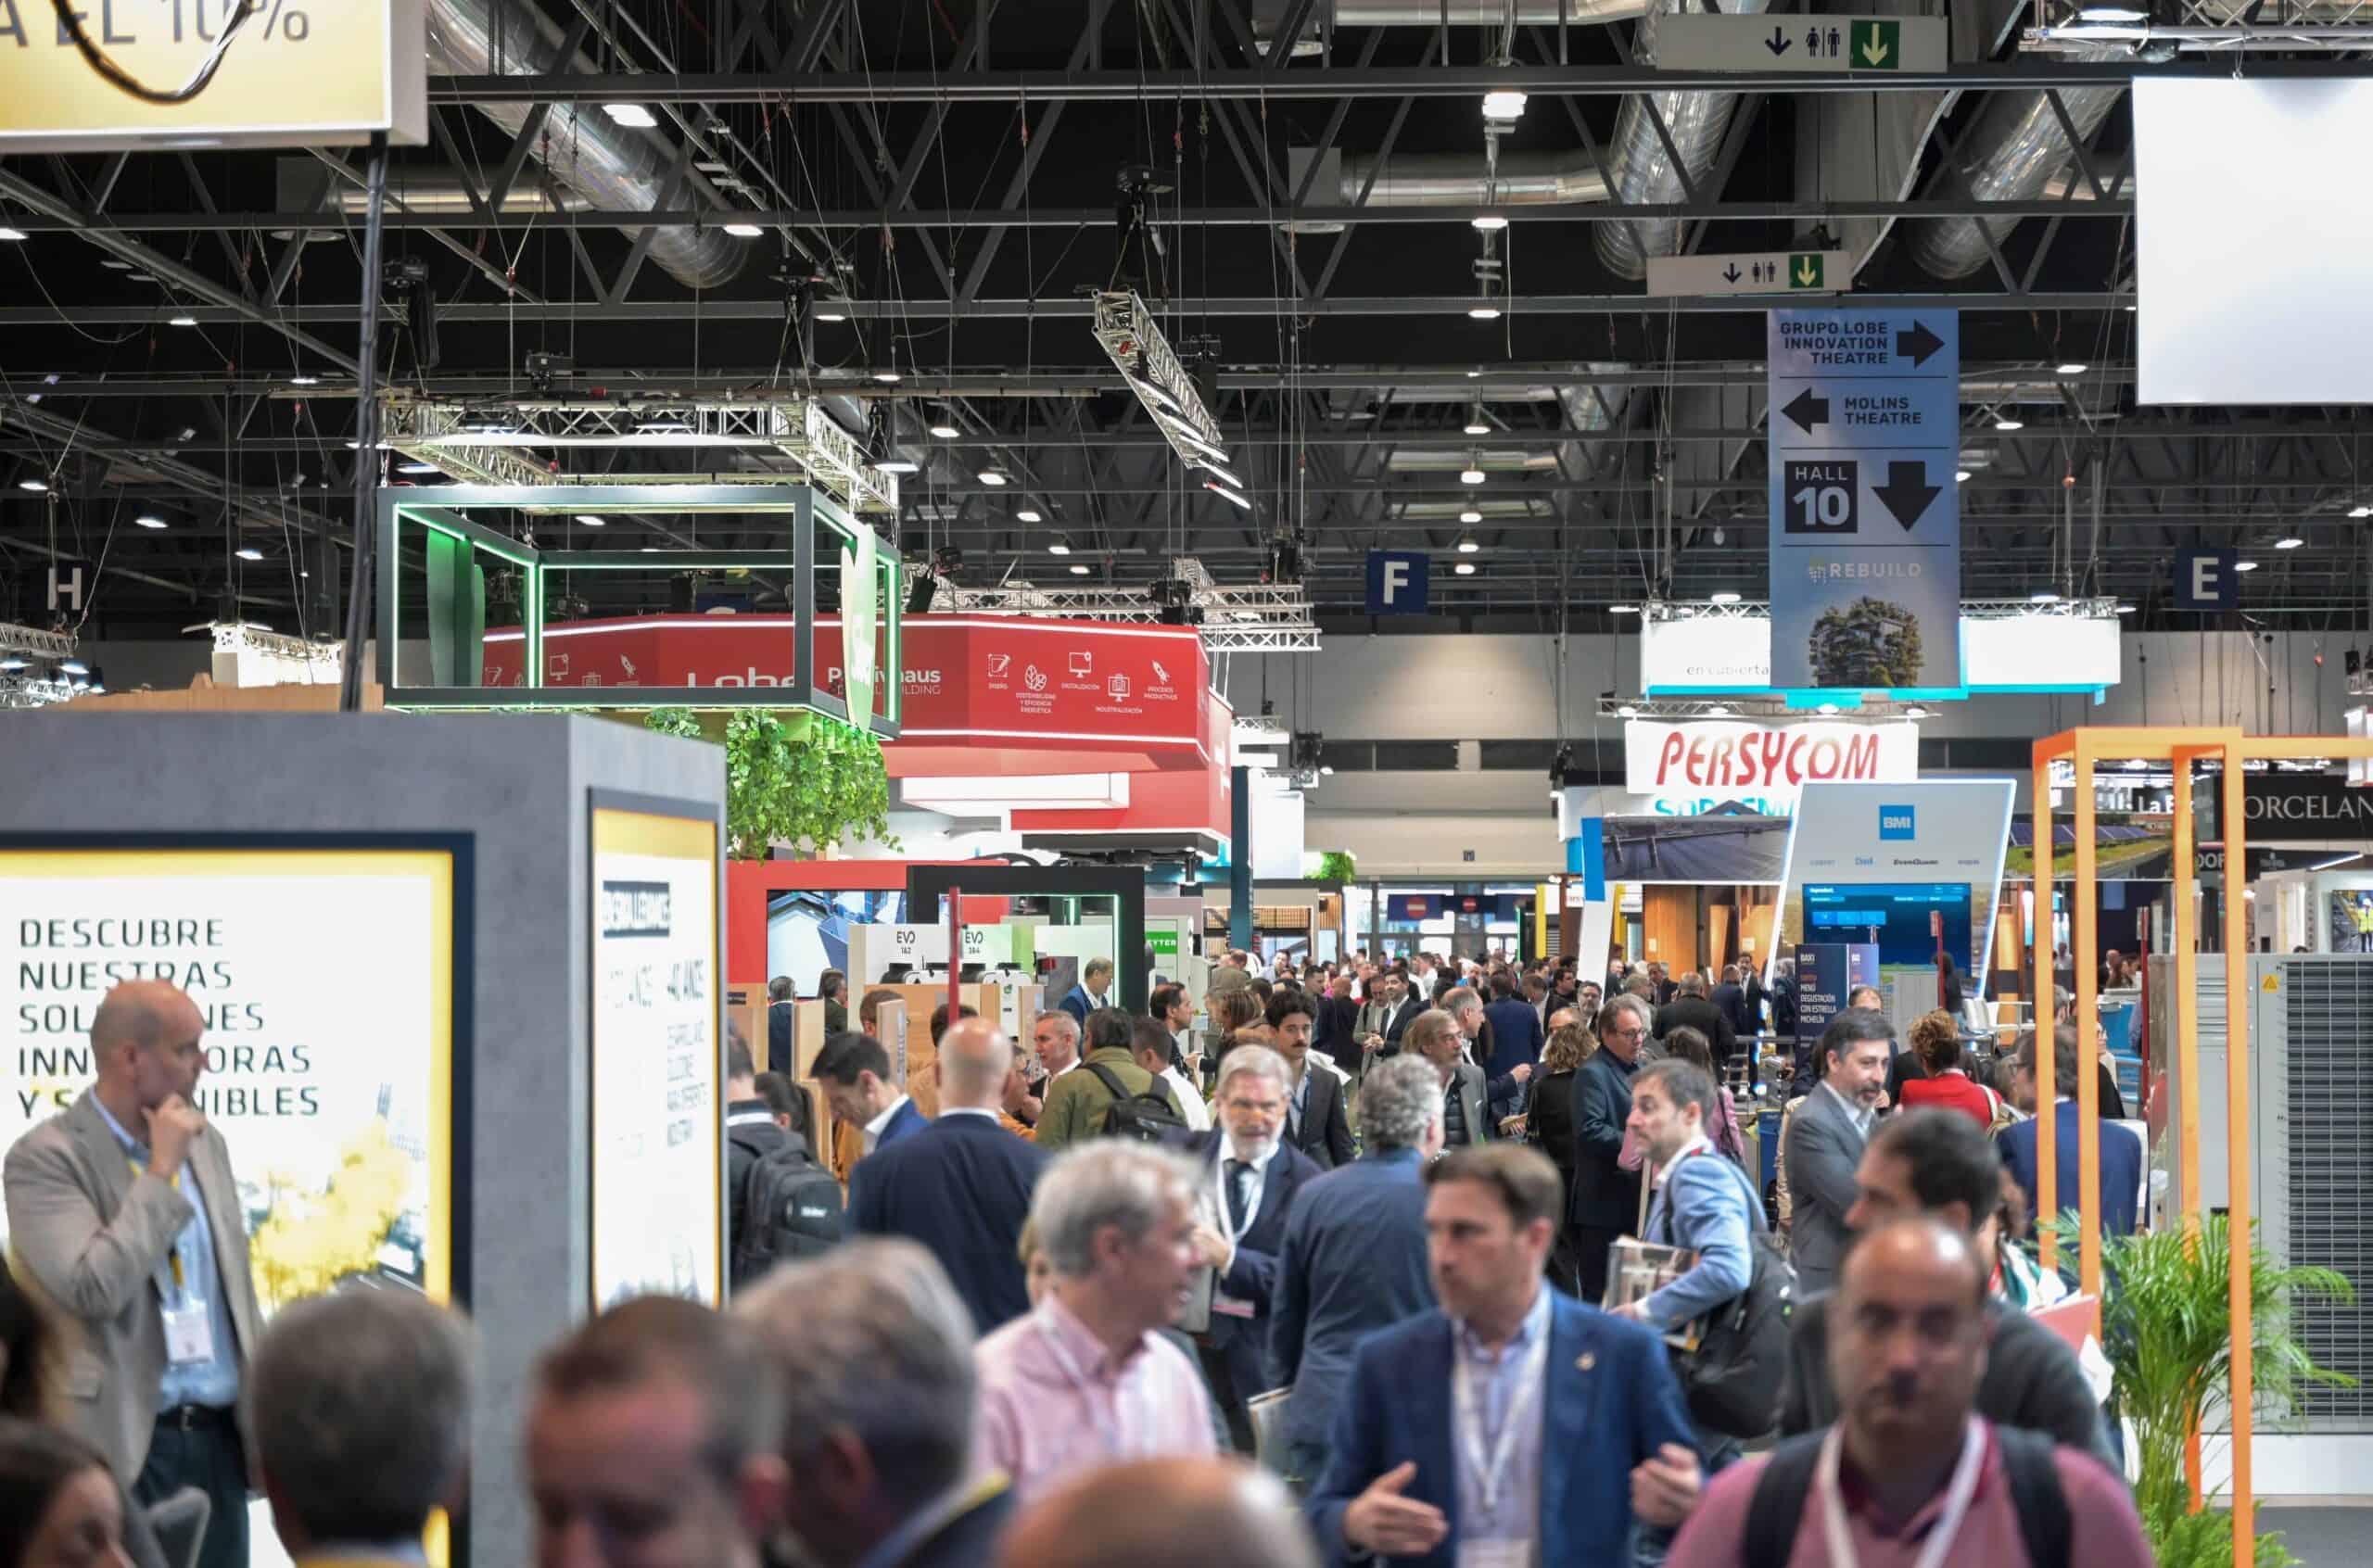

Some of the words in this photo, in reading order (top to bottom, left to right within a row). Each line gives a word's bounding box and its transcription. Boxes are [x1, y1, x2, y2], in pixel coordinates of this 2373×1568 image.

[1780, 322, 1838, 335] GRUPO
[1844, 322, 1887, 335] LOBE
[1784, 336, 1887, 349] INNOVATION
[1811, 352, 1888, 364] THEATRE
[1845, 397, 1909, 410] MOLINS
[1845, 412, 1921, 424] THEATRE
[1795, 466, 1847, 481] HALL
[1793, 487, 1849, 525] 10
[1830, 563, 1922, 578] REBUILD
[2192, 557, 2219, 600] E
[48, 567, 82, 610] H
[1383, 562, 1409, 604] F
[1656, 731, 1879, 787] PERSYCOM
[1883, 816, 1911, 828] BMI
[19, 918, 223, 948] DESCUBRE
[19, 960, 232, 991] NUESTRAS
[19, 1091, 40, 1119] Y
